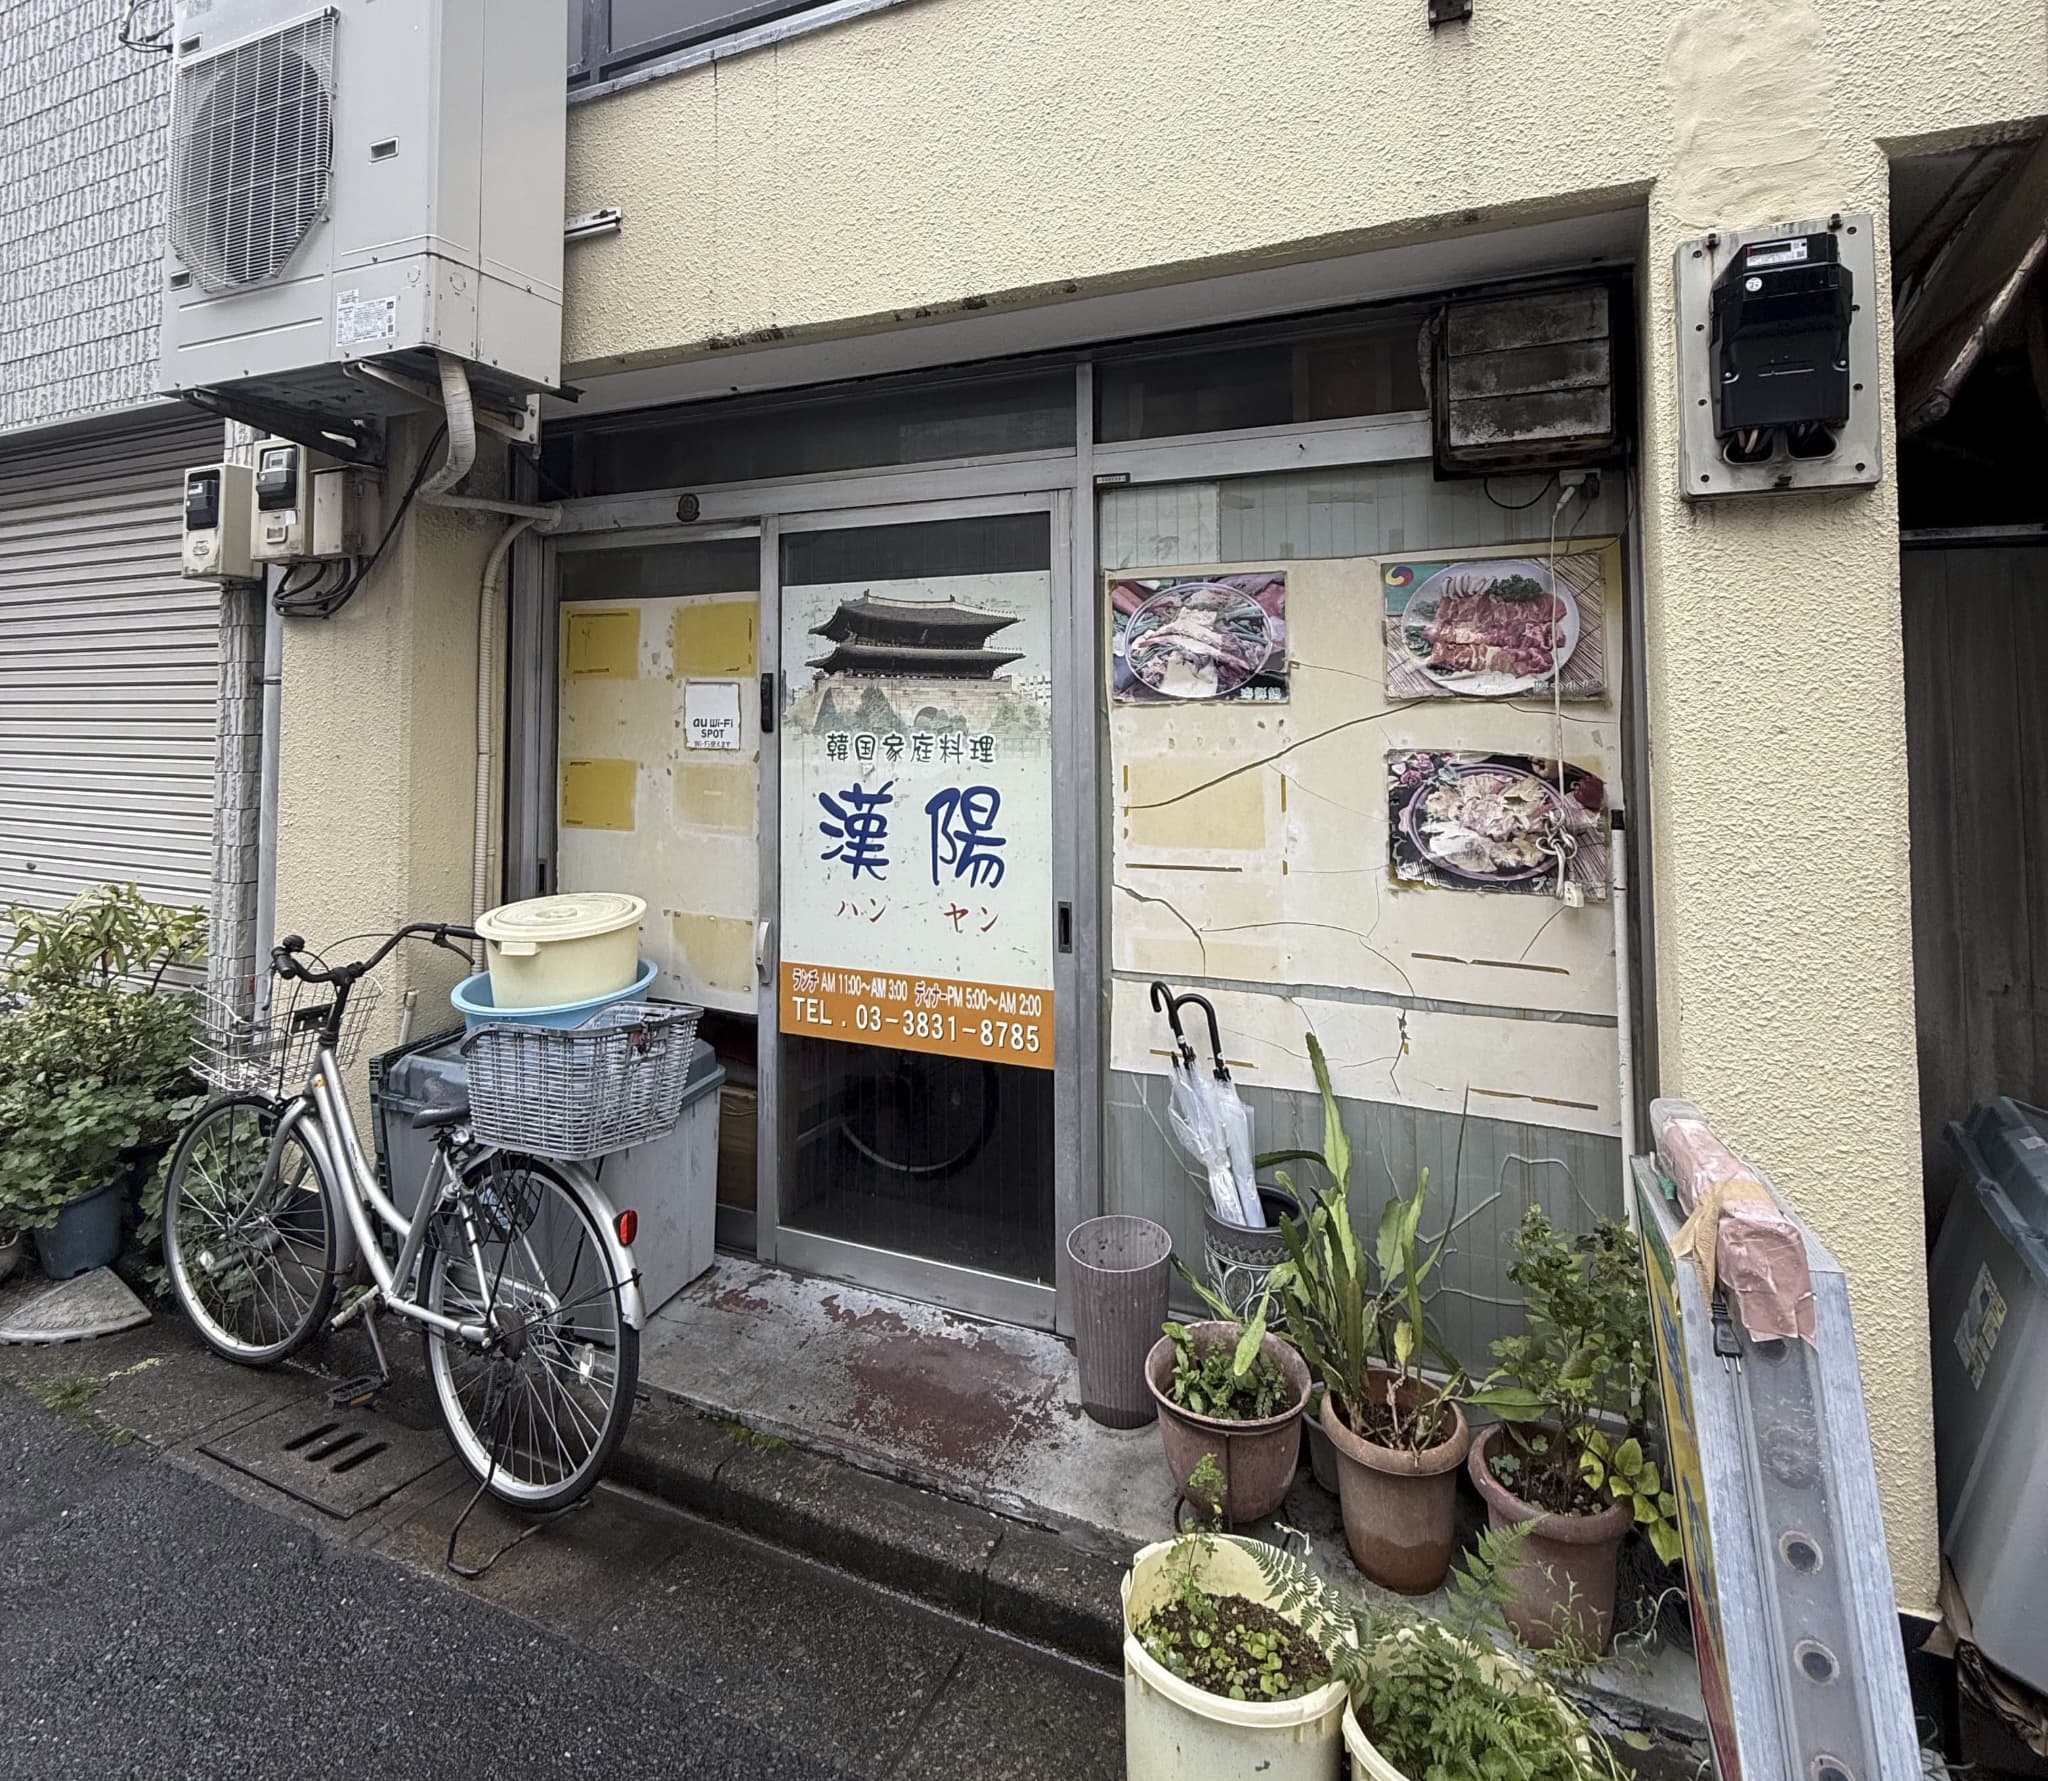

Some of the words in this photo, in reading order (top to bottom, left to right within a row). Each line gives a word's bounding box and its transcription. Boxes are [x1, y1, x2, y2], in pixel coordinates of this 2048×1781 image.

[692, 718, 708, 728] au
[709, 718, 734, 728] Wi-Fi
[701, 729, 725, 738] SPOT
[826, 733, 995, 764] 韓国家庭料理
[818, 780, 1007, 889] 漢陽
[820, 972, 836, 993] AM
[888, 978, 908, 1001] 3:00
[1018, 992, 1042, 1017] 2:00
